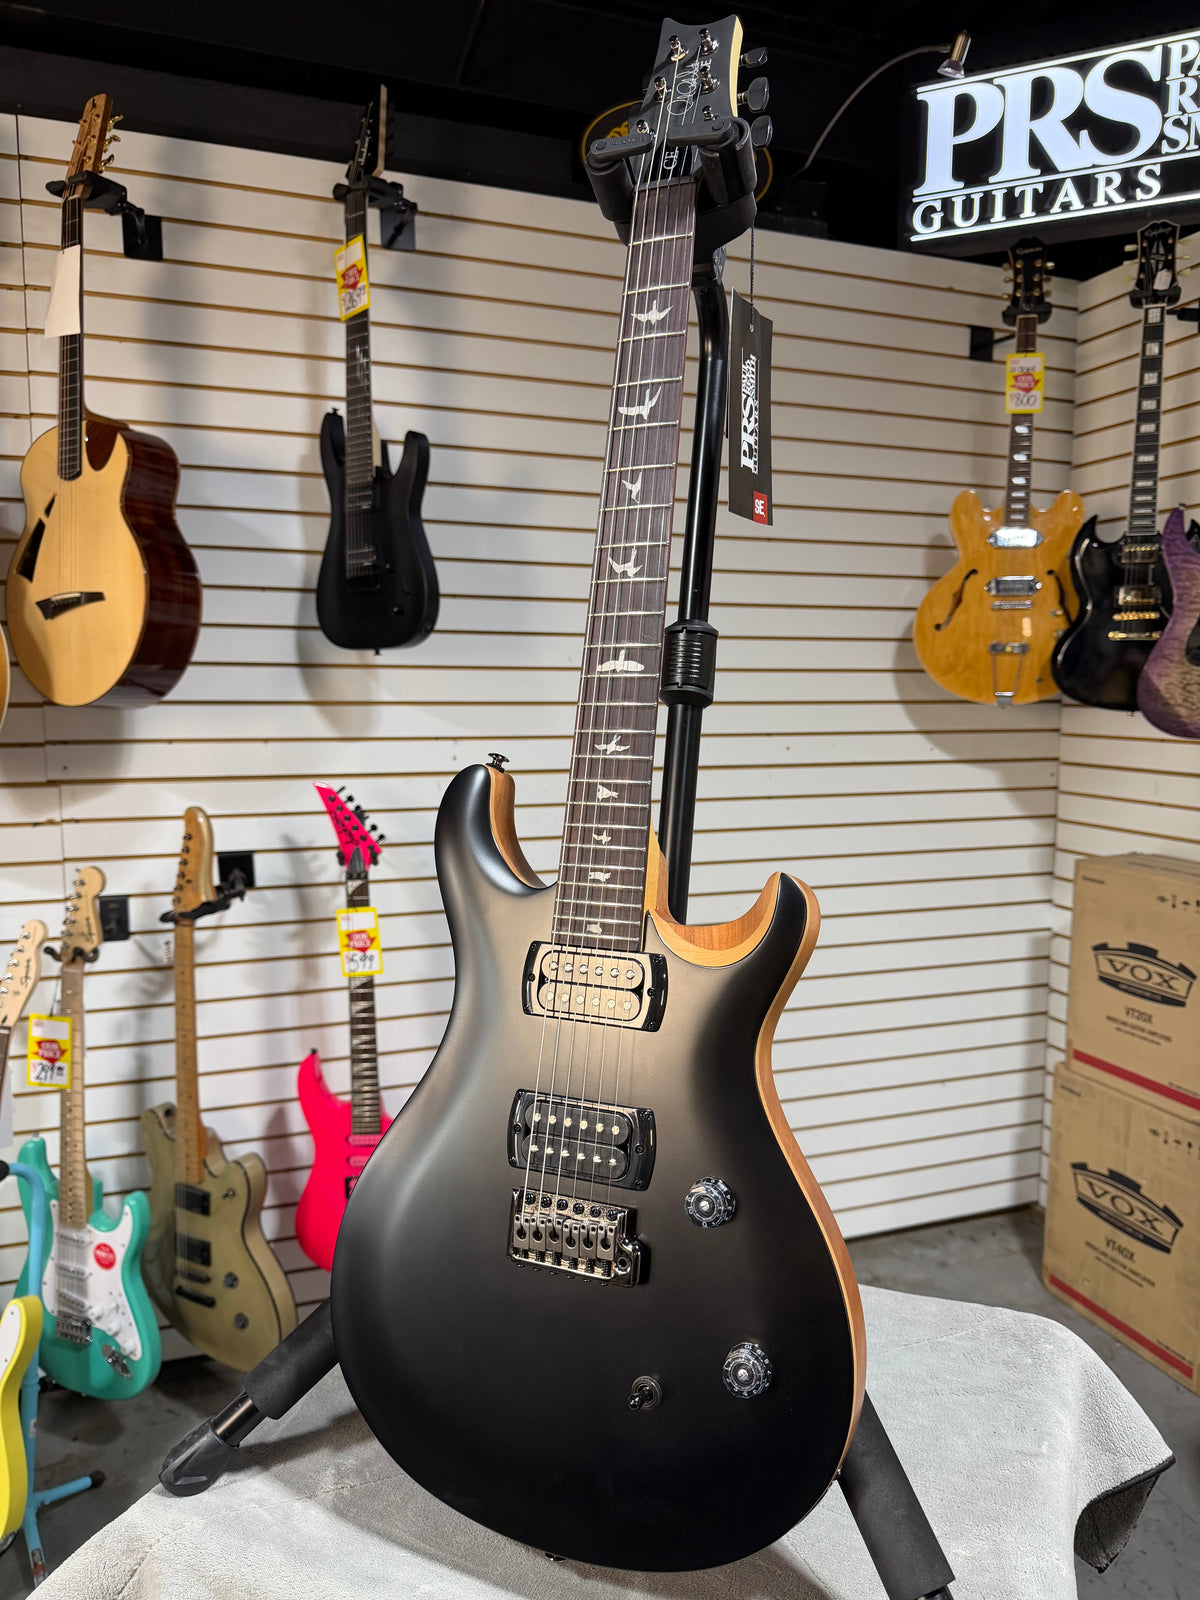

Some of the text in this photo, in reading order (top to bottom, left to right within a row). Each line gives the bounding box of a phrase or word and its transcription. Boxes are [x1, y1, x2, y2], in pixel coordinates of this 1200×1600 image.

[913, 45, 1162, 195] PRS
[663, 151, 679, 170] CE
[912, 164, 1161, 234] GUITARS
[741, 390, 756, 474] PRS
[754, 498, 764, 515] SE
[1104, 956, 1179, 992] VOX
[1084, 1178, 1163, 1236] VOX
